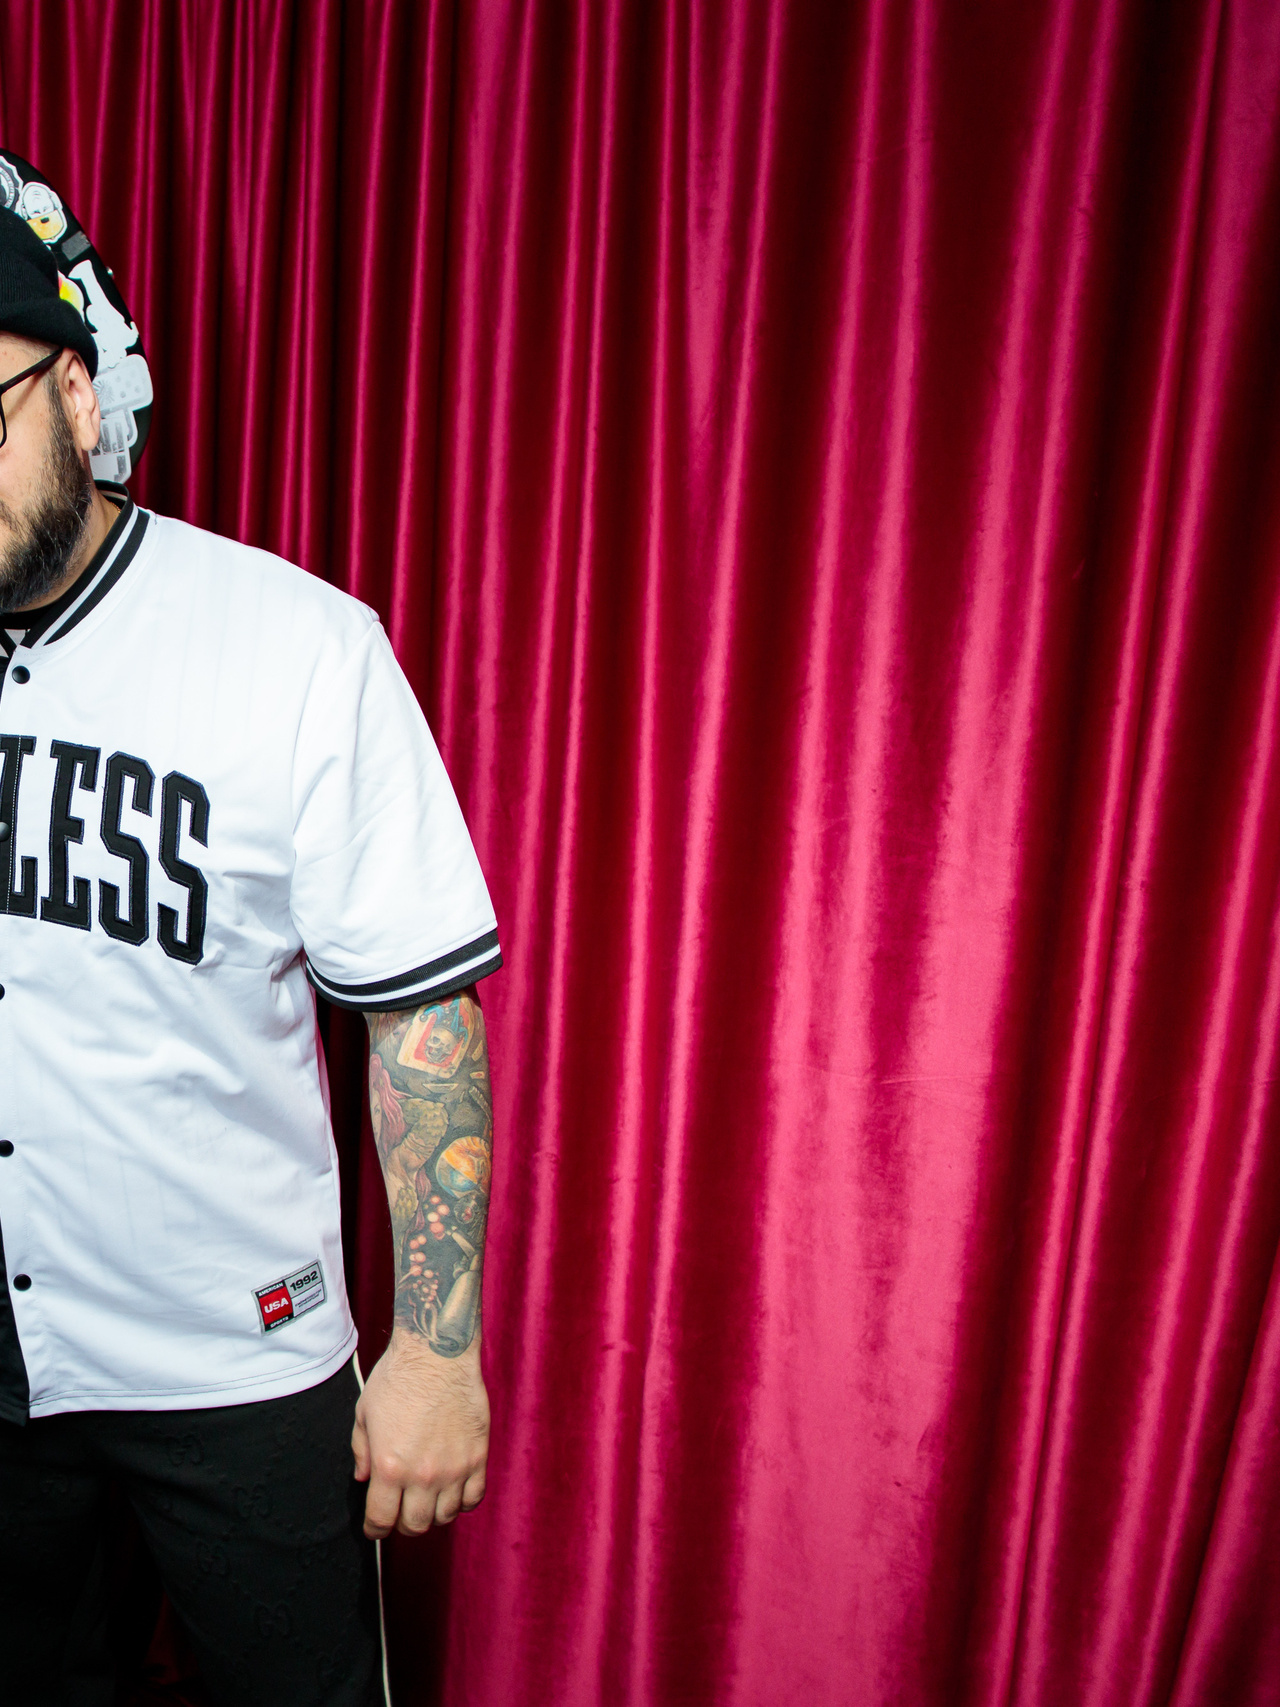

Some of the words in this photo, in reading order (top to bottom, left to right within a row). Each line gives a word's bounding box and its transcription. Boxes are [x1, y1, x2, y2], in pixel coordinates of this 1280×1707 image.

[290, 1270, 318, 1291] 1992
[258, 1282, 284, 1297] AMERICAN
[264, 1297, 289, 1314] USA
